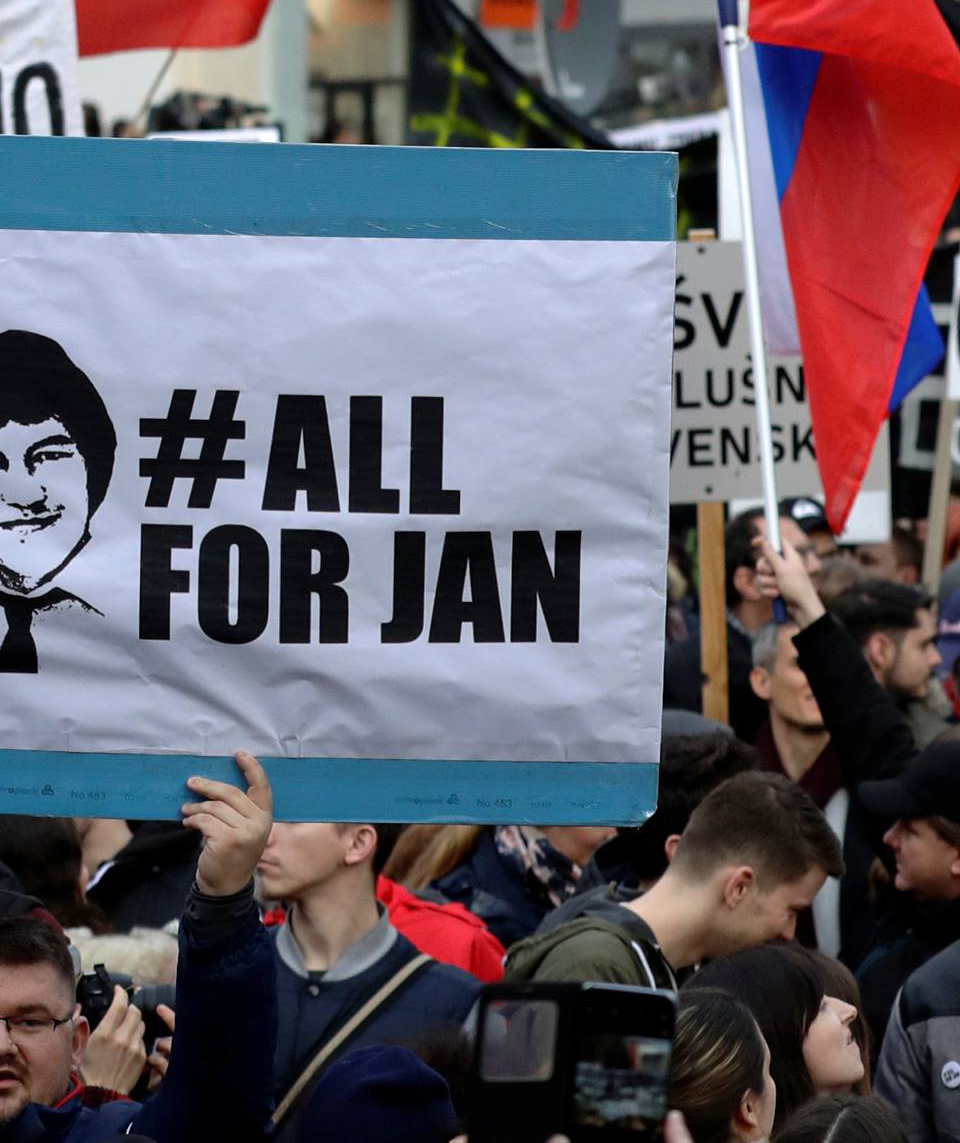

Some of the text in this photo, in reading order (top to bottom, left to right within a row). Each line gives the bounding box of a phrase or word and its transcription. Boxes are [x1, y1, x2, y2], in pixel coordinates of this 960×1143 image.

[139, 389, 461, 514] #ALL
[139, 524, 582, 645] FOR JAN
